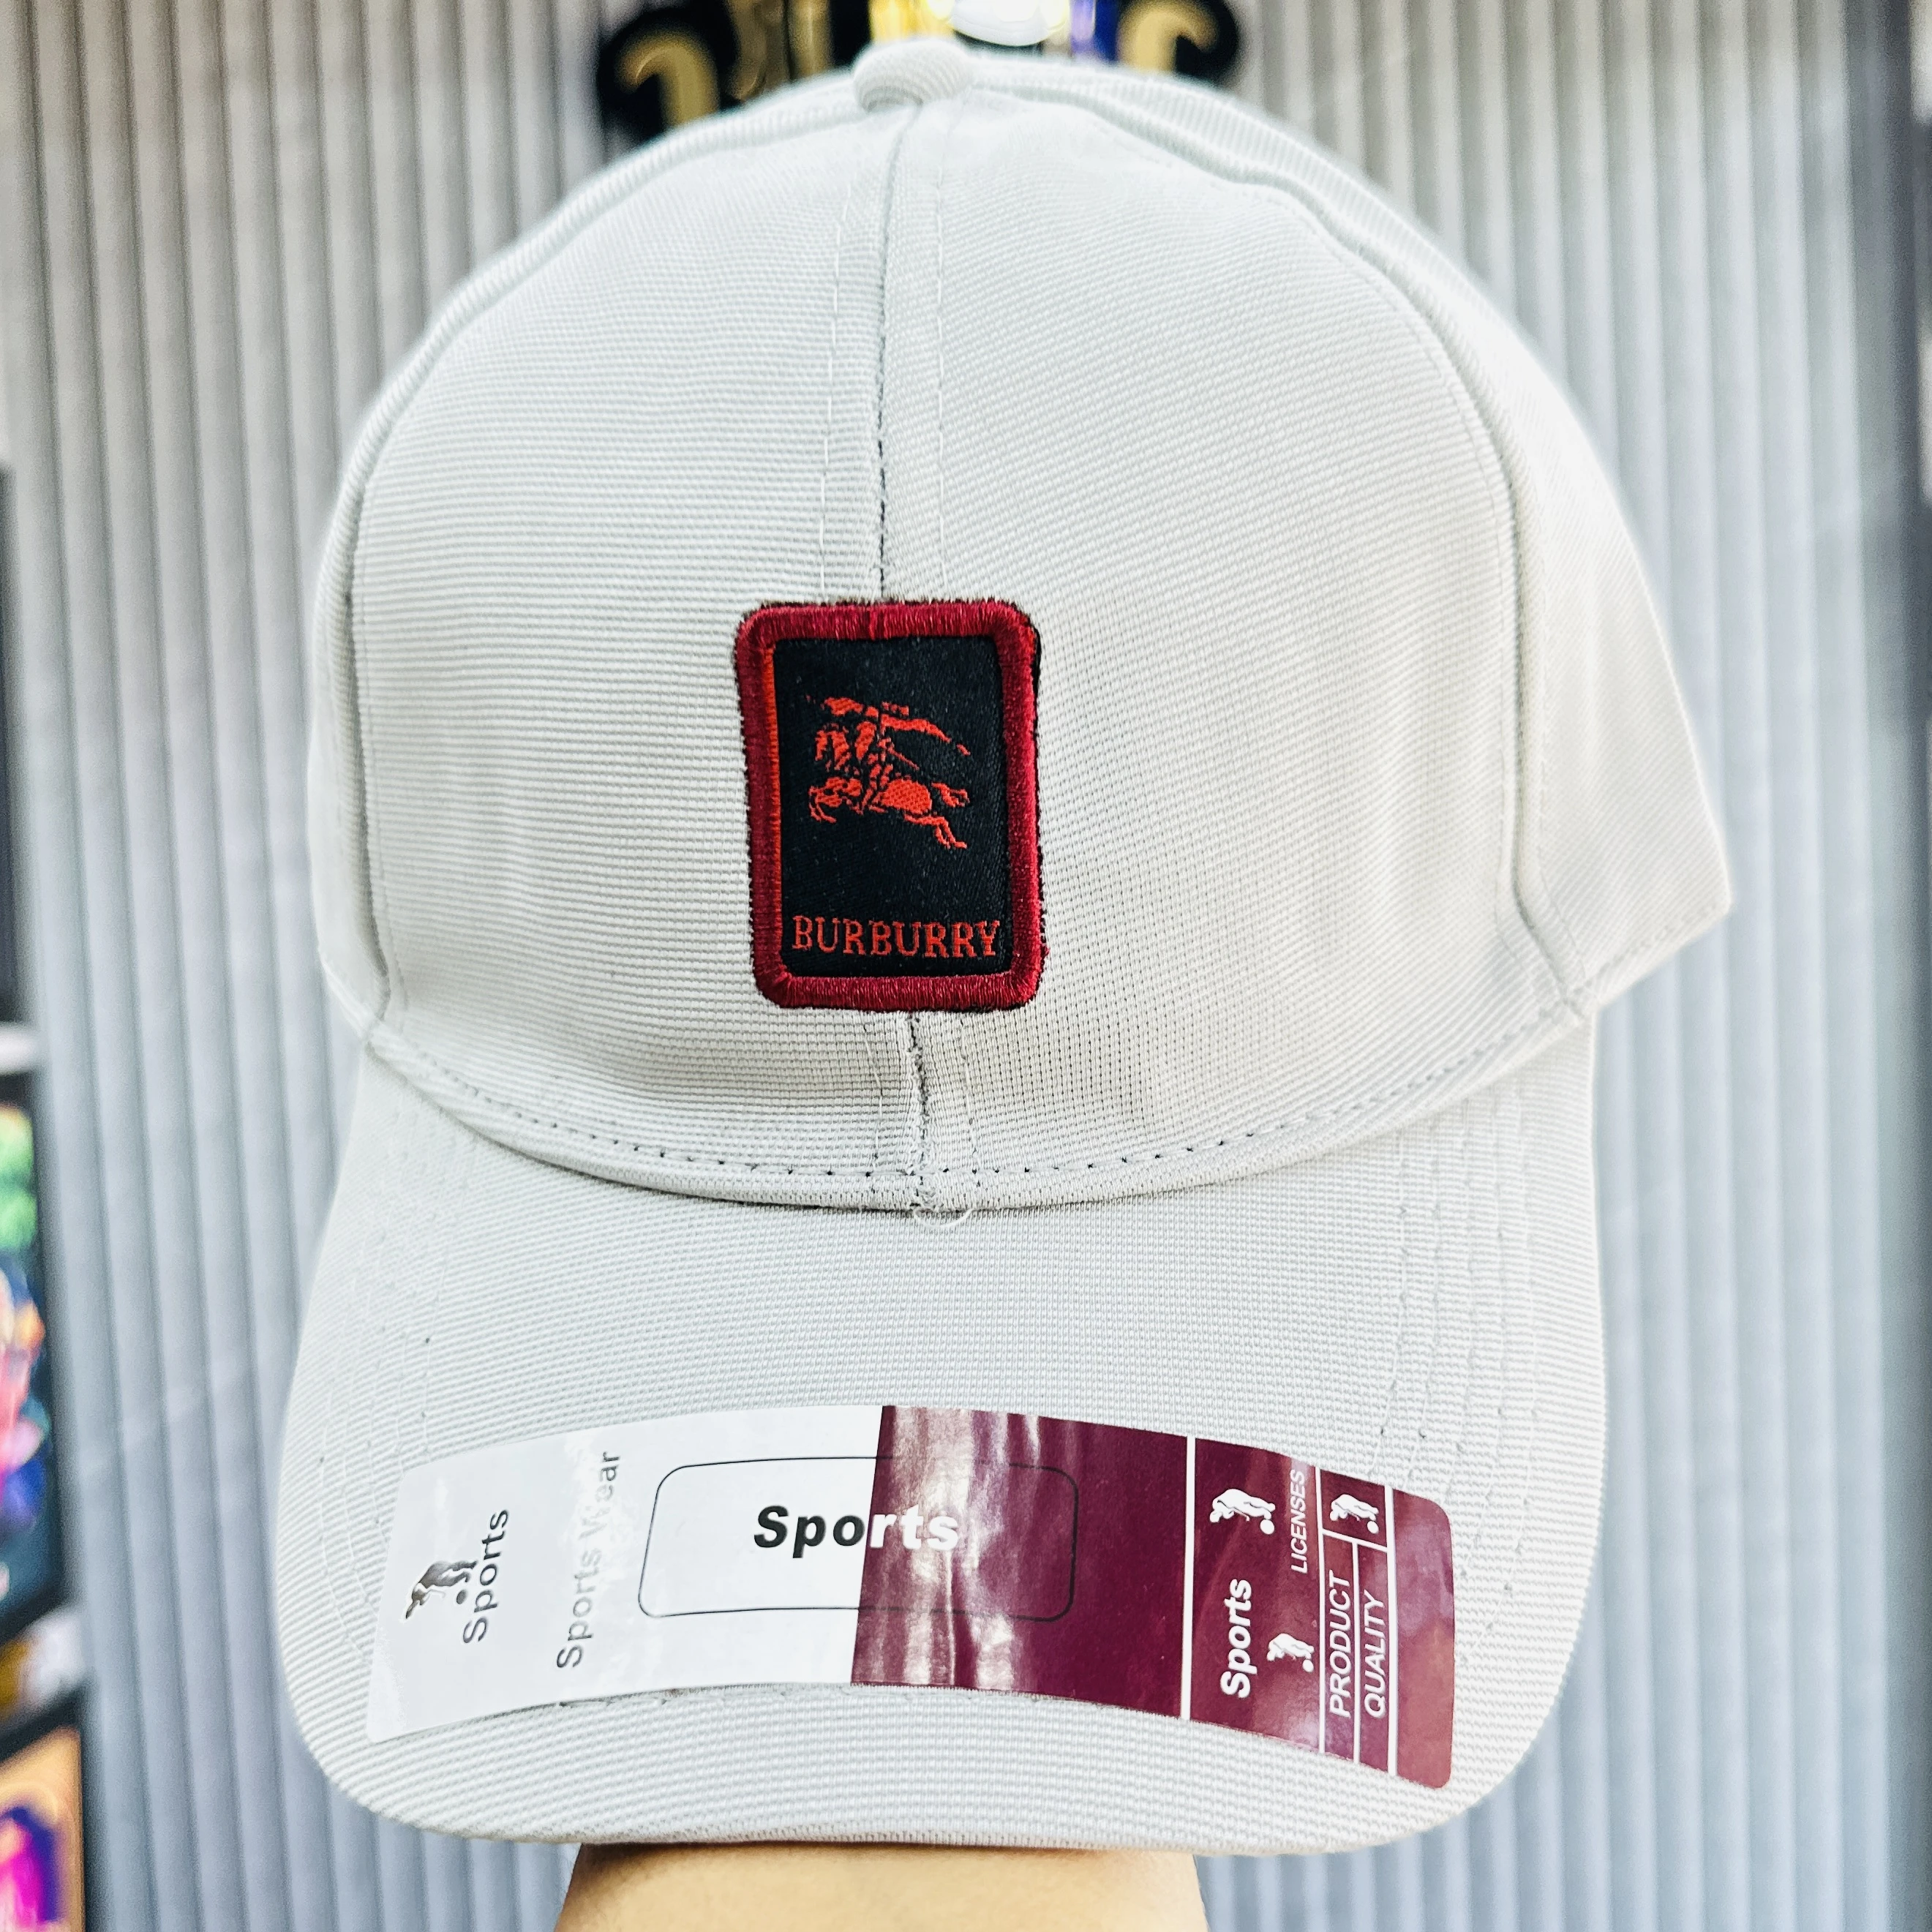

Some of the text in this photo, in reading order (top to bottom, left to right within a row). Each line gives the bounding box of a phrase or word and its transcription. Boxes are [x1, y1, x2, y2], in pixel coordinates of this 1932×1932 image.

[792, 915, 1000, 958] BURBURRY
[462, 1509, 508, 1644] Sports
[753, 1505, 959, 1559] Sports
[1290, 1468, 1308, 1574] LICENSES
[556, 1547, 601, 1668] Sports
[1220, 1579, 1258, 1698] Sports
[1329, 1570, 1352, 1718] PRODUCT
[1364, 1590, 1386, 1718] QUALITY
